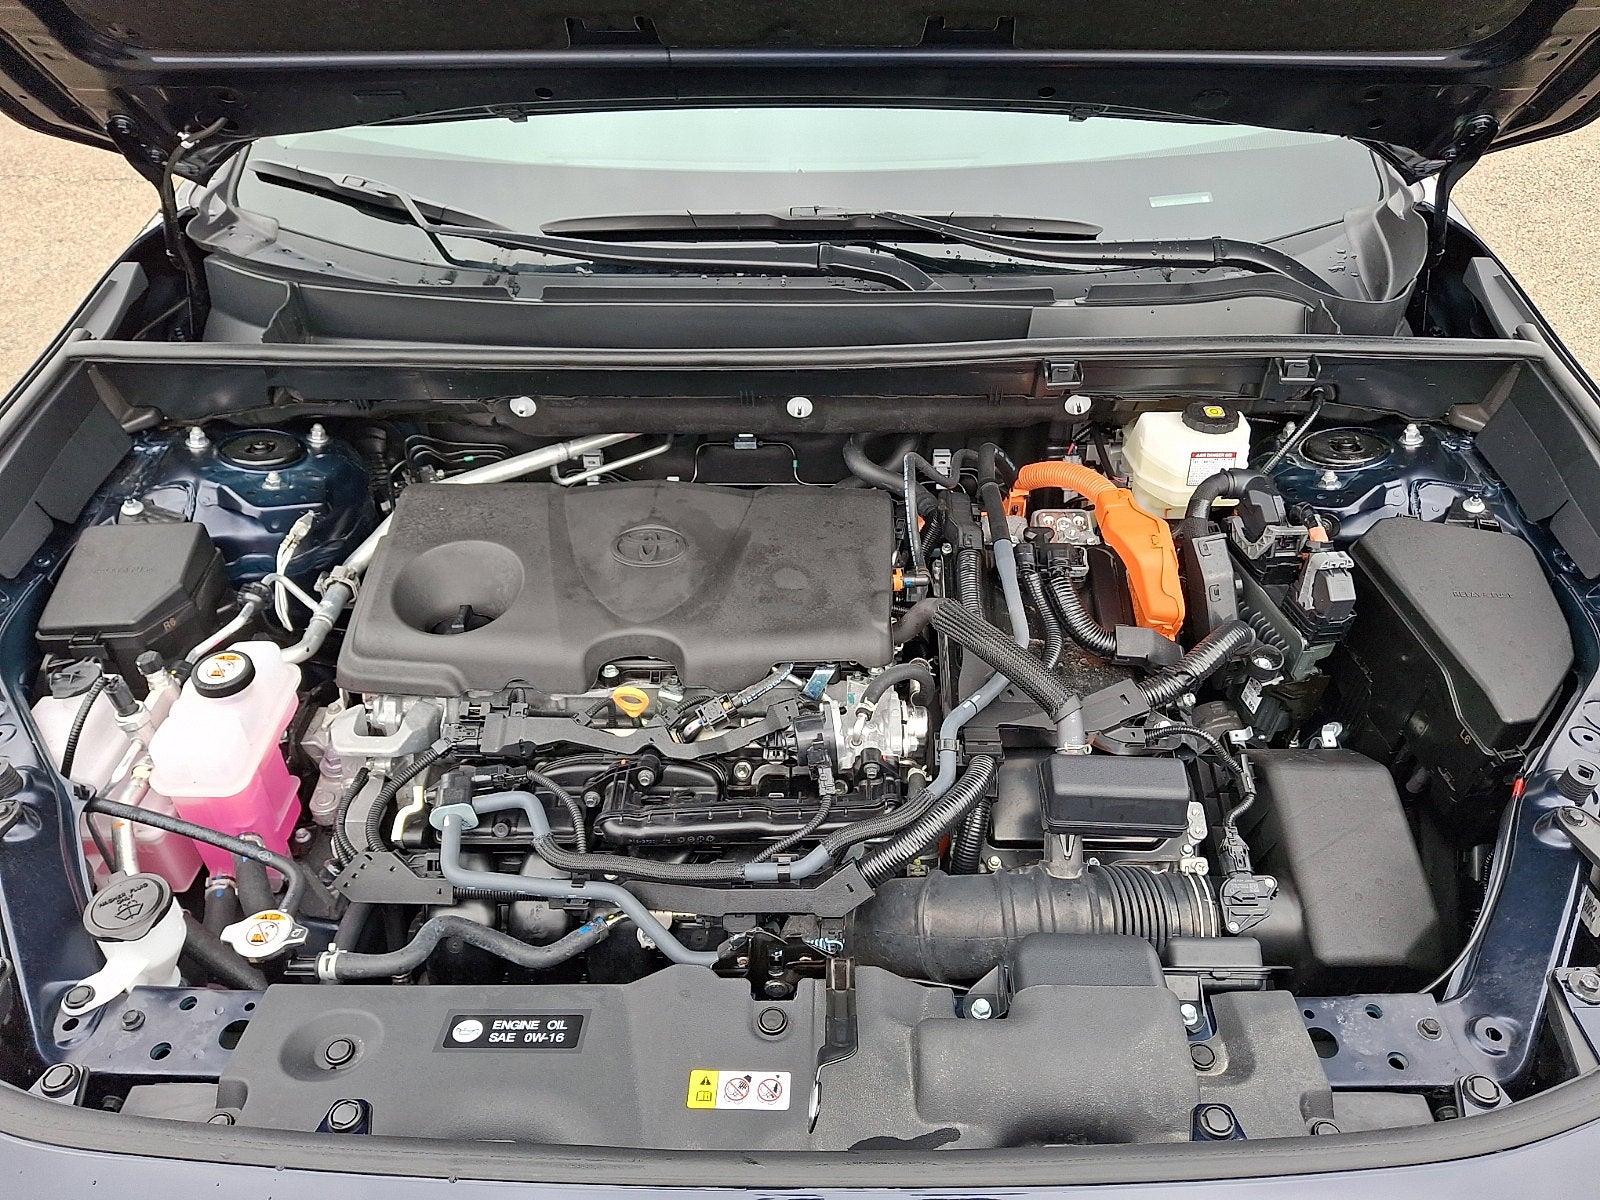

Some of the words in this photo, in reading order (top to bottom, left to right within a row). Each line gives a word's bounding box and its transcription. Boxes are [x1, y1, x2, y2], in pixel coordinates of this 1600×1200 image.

[163, 617, 177, 632] R6
[98, 892, 127, 909] WASHER
[129, 882, 149, 895] FLUID
[116, 894, 134, 905] ONLY
[492, 1019, 541, 1030] ENGINE
[547, 1019, 568, 1030] OIL
[488, 1032, 516, 1043] SAE
[523, 1032, 565, 1043] 0W-16
